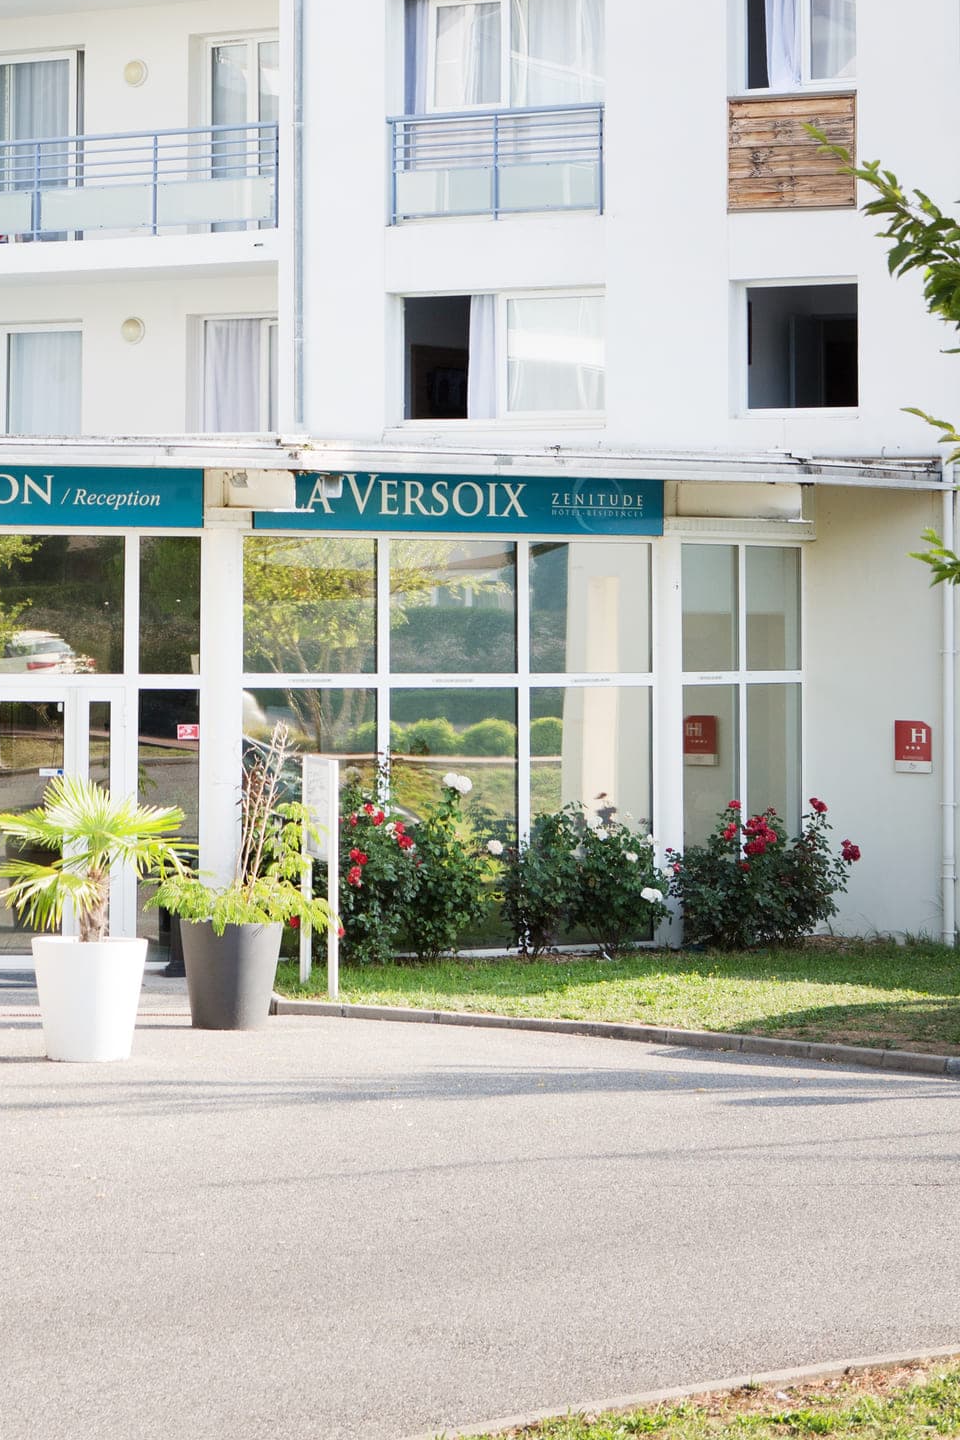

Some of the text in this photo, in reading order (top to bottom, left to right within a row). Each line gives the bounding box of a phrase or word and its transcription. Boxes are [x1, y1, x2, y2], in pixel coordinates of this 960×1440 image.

[72, 488, 161, 511] Reception
[343, 473, 528, 518] VERSOIX
[551, 492, 644, 507] ZENITUDE
[911, 728, 927, 744] H
